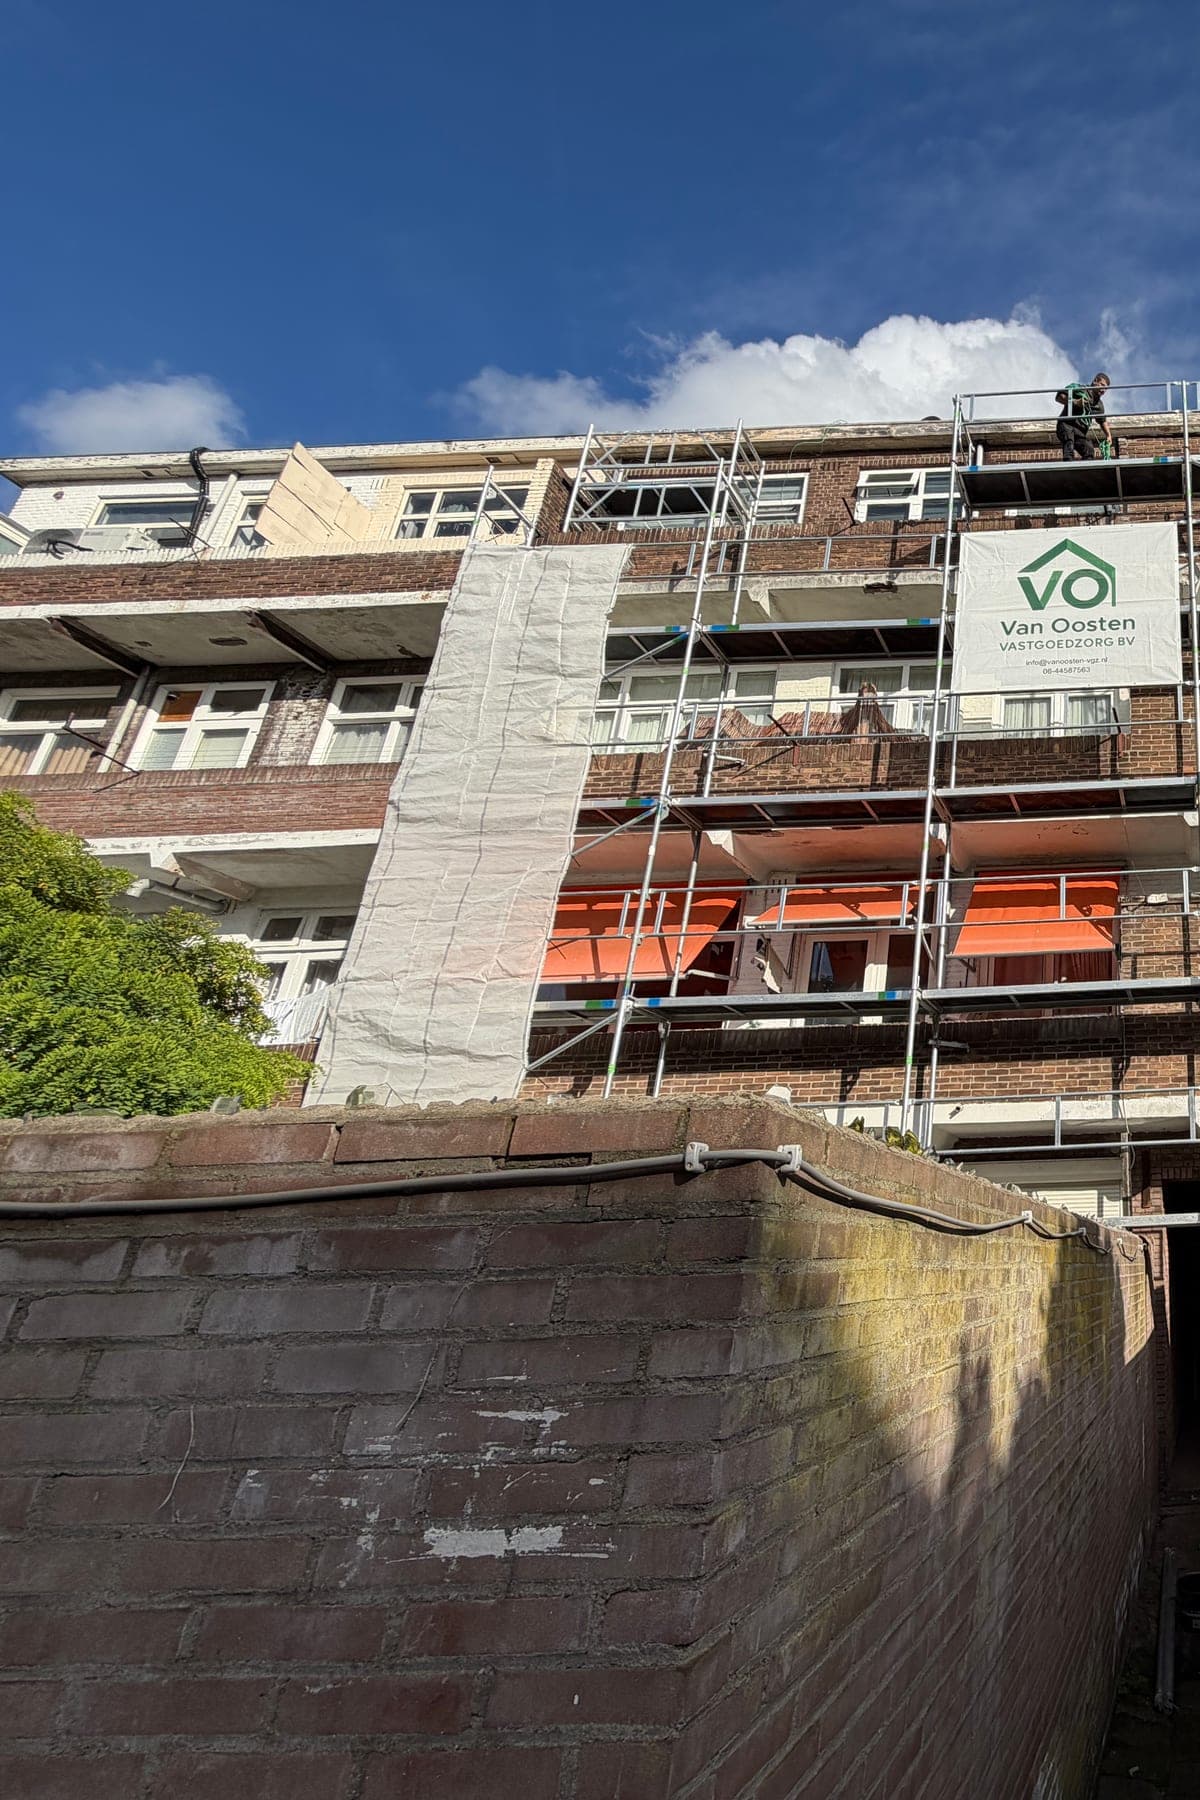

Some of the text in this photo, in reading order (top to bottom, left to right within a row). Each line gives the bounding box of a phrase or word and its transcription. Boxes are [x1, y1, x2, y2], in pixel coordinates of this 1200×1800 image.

[1017, 569, 1109, 610] VO
[1000, 617, 1136, 636] Van Oosten
[999, 636, 1136, 652] VASTGOEDZORG BV
[1025, 656, 1108, 667] info@vanoosten-vgz.nl
